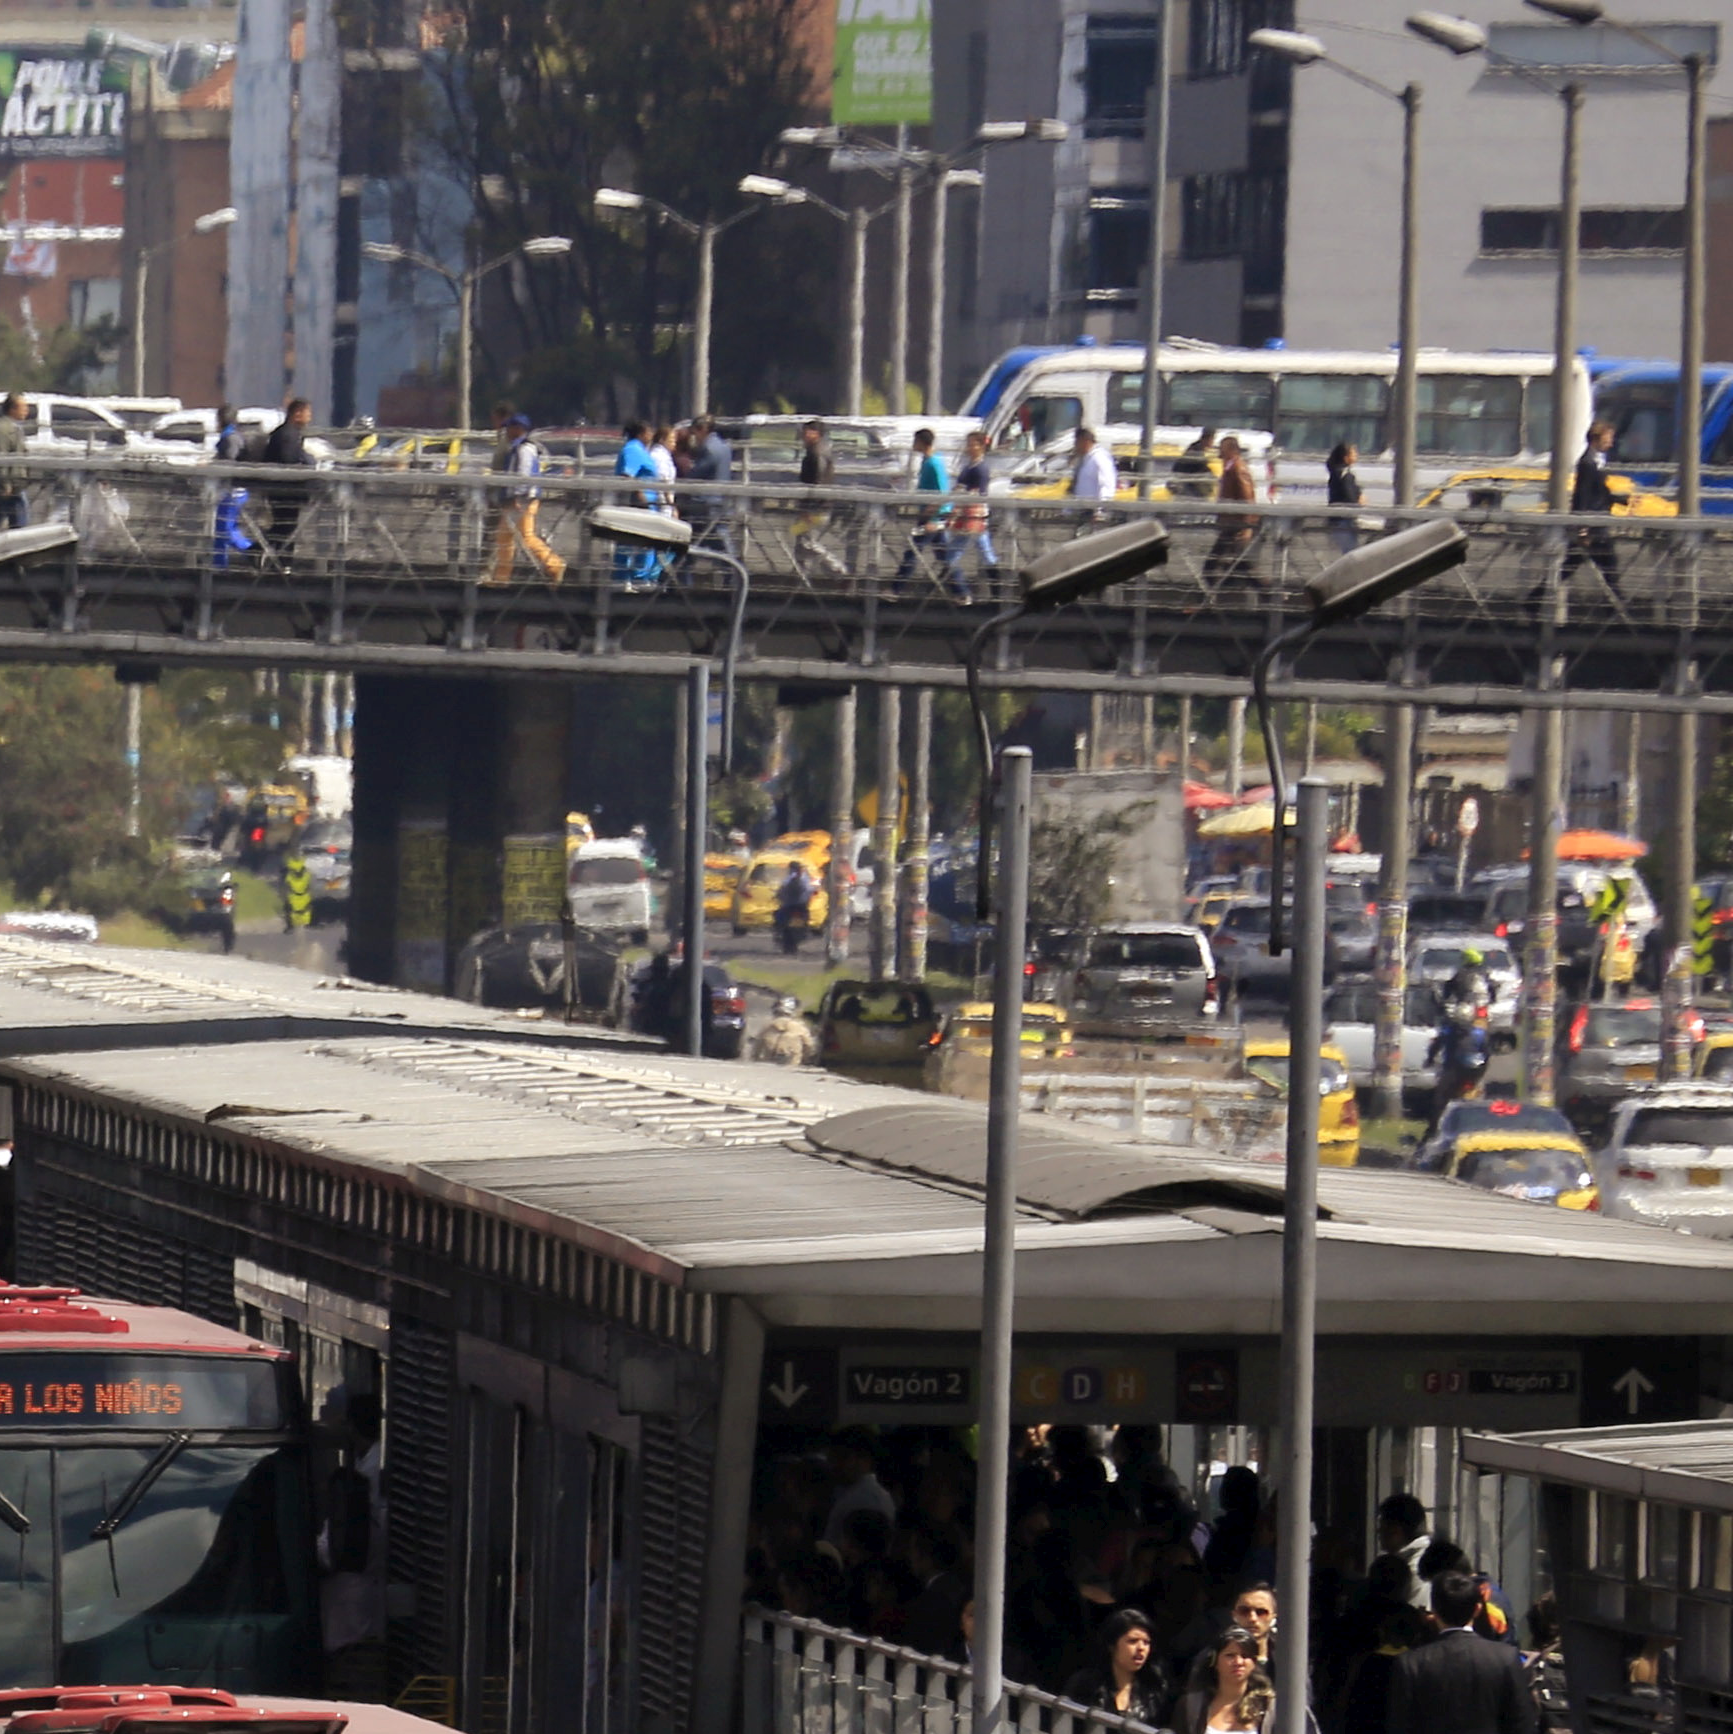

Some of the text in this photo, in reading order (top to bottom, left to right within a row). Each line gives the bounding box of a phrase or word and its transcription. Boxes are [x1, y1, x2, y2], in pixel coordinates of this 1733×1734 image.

[853, 1372, 962, 1399] Vagón 2
[1073, 1375, 1091, 1399] D
[1116, 1377, 1135, 1399] H
[1490, 1373, 1569, 1392] Vagón 3
[24, 1384, 83, 1413] LOS
[96, 1378, 182, 1415] NIÑOS
